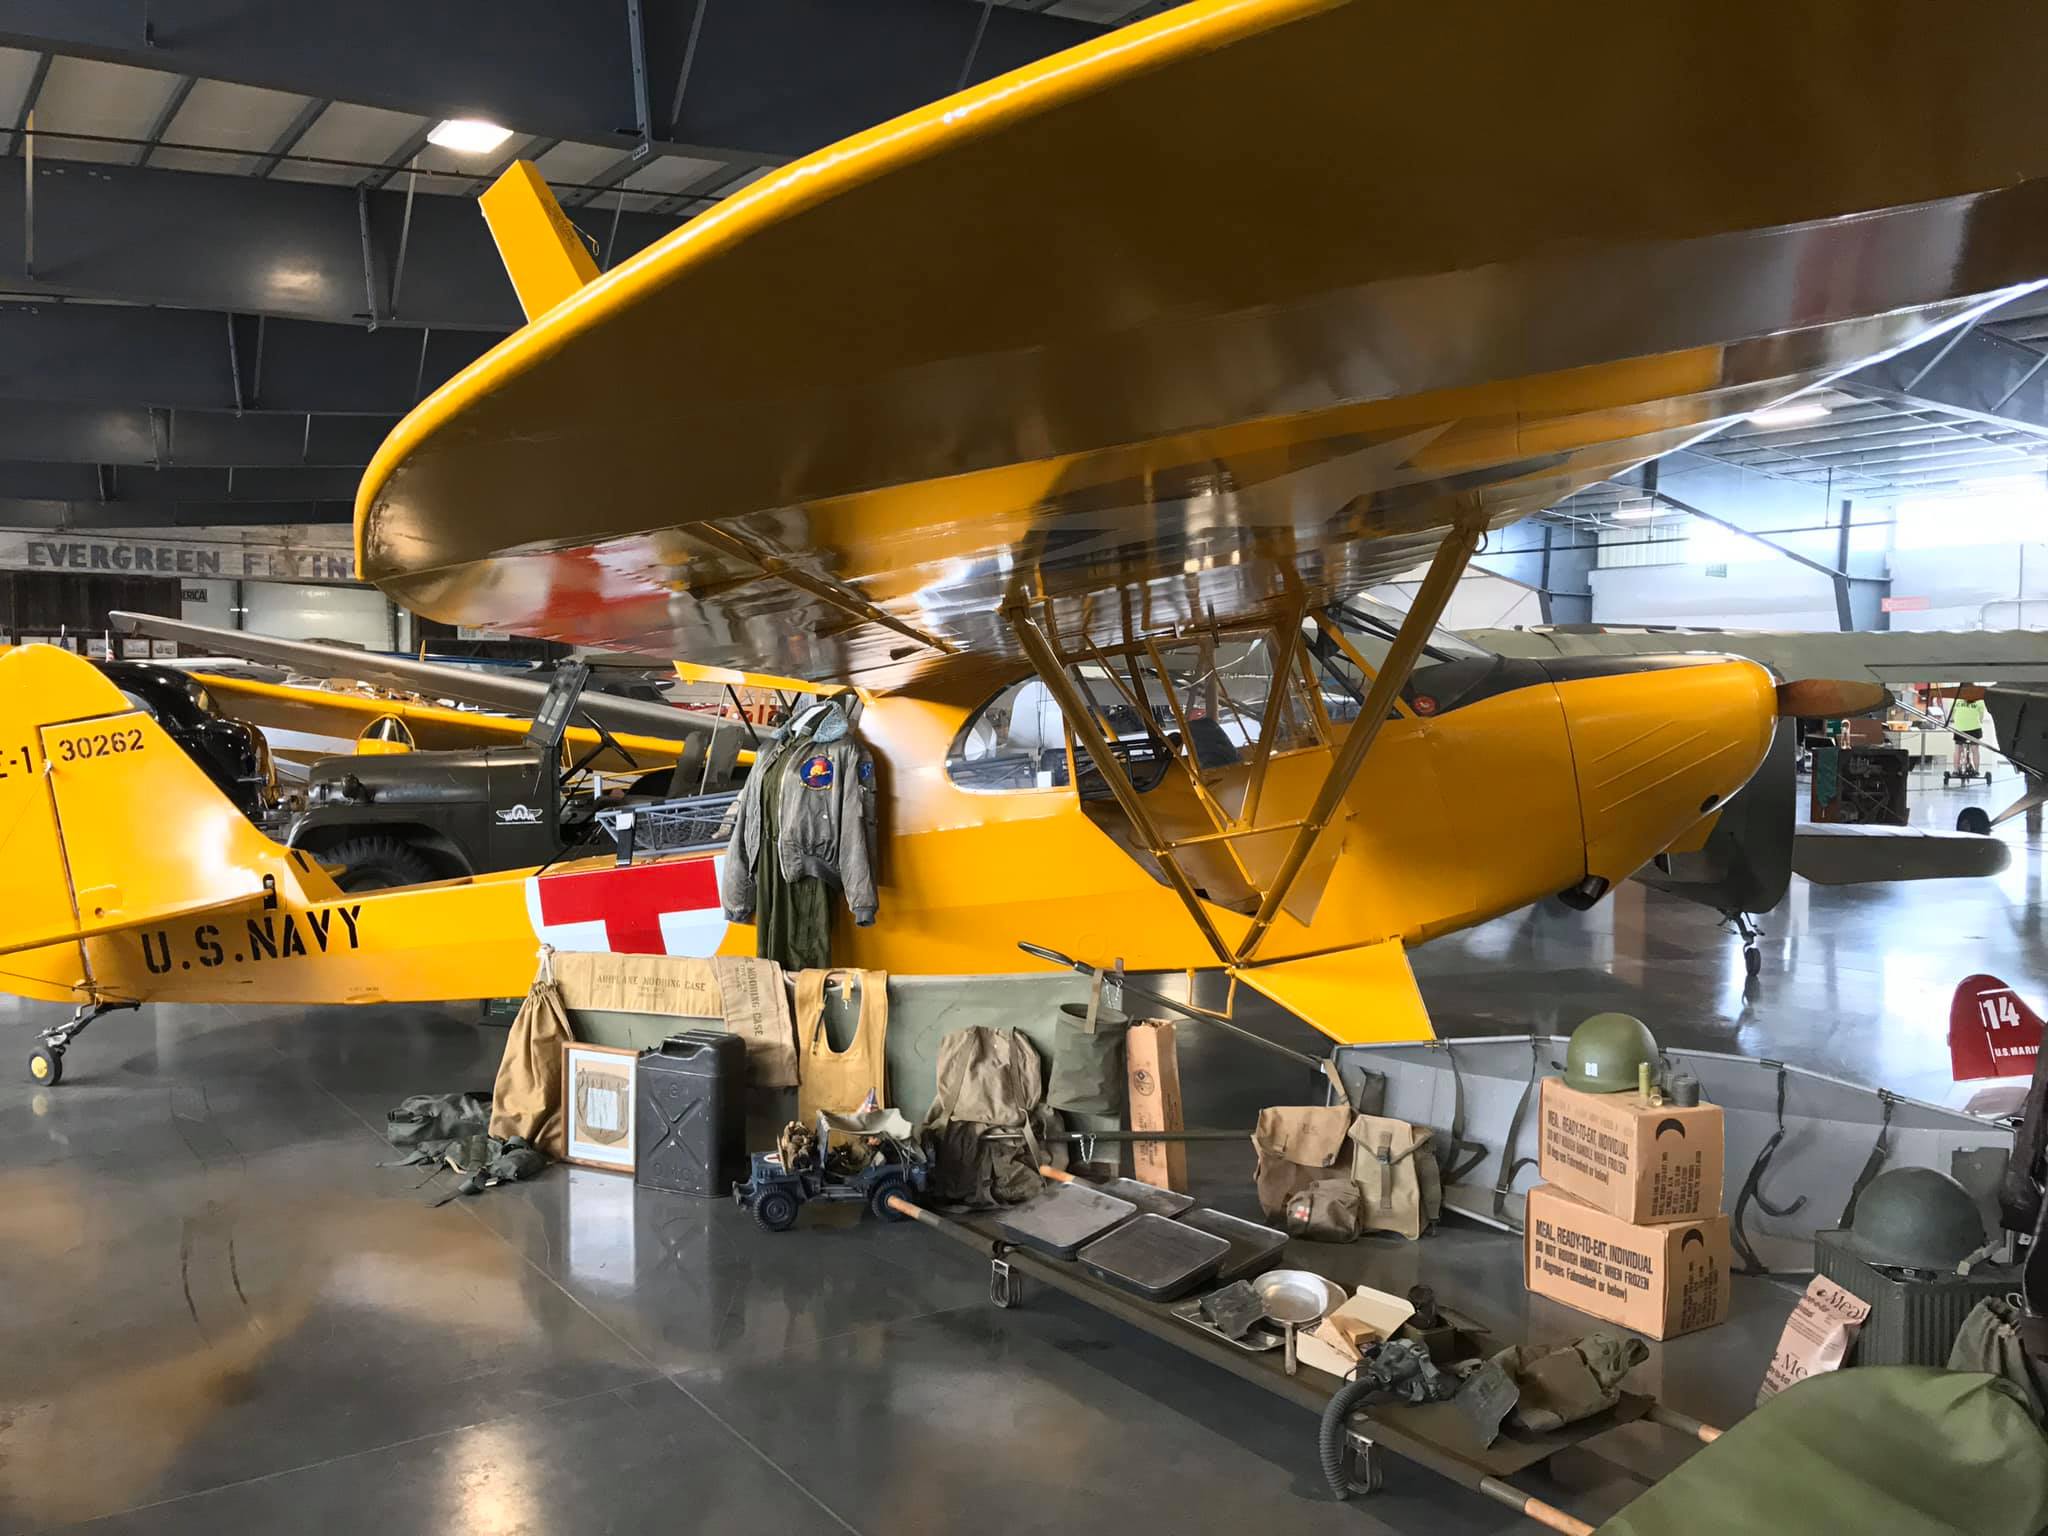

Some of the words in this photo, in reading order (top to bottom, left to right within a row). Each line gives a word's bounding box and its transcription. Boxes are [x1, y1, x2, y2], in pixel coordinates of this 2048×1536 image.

[27, 541, 220, 574] EVERGREEN
[243, 552, 357, 578] FLYIN
[59, 728, 145, 762] 30262
[684, 980, 706, 992] CASE
[753, 1012, 764, 1037] CASE
[1982, 996, 2020, 1030] 14
[1598, 1132, 1629, 1161] INDIVIDUAL
[1608, 1156, 1627, 1176] FROZEN
[1535, 1239, 1544, 1253] DO
[1545, 1243, 1556, 1258] NOT
[1558, 1247, 1579, 1266] ROUGH
[1579, 1255, 1602, 1275] HANDLE
[1604, 1263, 1623, 1282] WHEN
[1624, 1270, 1649, 1291] FROZEN
[1609, 1244, 1653, 1275] INDIVIDUAL
[1543, 1259, 1565, 1279] degrees
[1566, 1267, 1597, 1290] Fahrenheit
[1598, 1281, 1605, 1292] or
[1826, 1290, 1867, 1321] Meal
